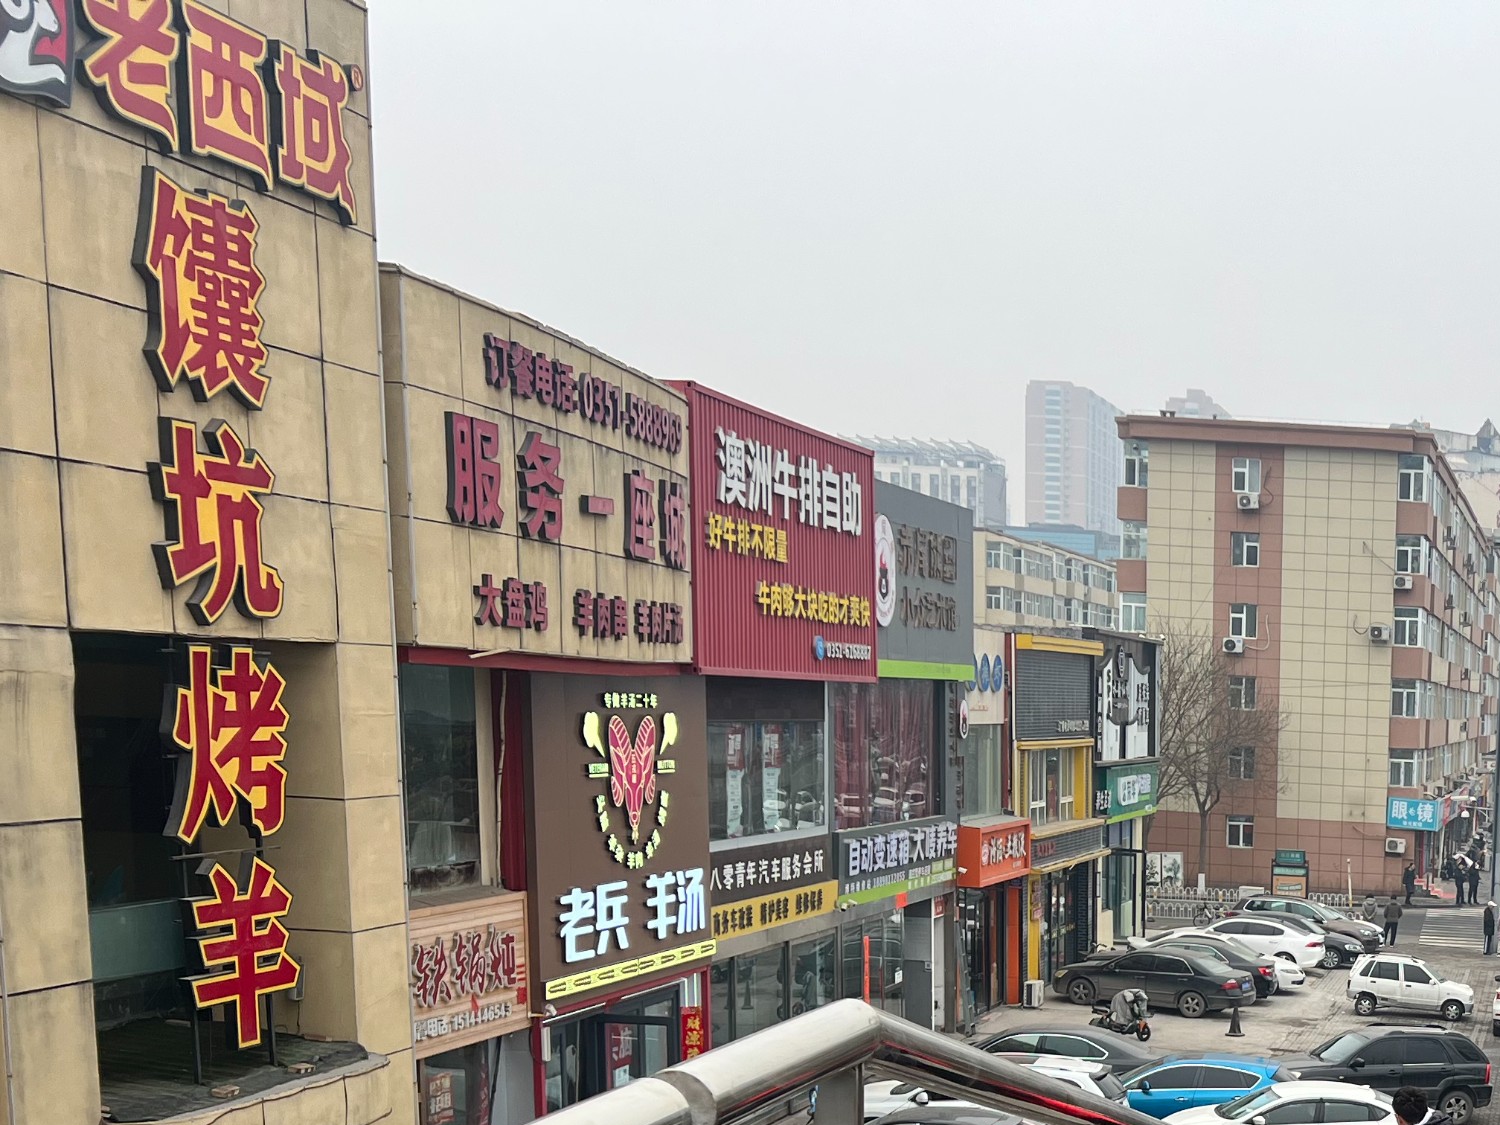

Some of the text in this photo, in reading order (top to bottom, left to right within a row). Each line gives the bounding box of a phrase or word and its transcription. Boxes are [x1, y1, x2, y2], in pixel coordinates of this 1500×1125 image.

[77, 0, 357, 225] 老西域
[446, 411, 686, 569] 服务一座城
[715, 426, 861, 536] 澳洲牛排自助
[706, 511, 788, 563] 好牛排不限量
[132, 166, 300, 1049] 馕坑烤羊
[473, 574, 549, 631] 大盘鸡
[573, 589, 628, 640] 羊肉串
[756, 580, 871, 627] 牛肉够大块吃的才爽快
[710, 849, 823, 891] 八零青年汽车服务会所
[845, 830, 909, 876] 自动变速箱
[560, 868, 705, 963] 老兵 羊汤
[413, 924, 517, 1007] 铁锅炖
